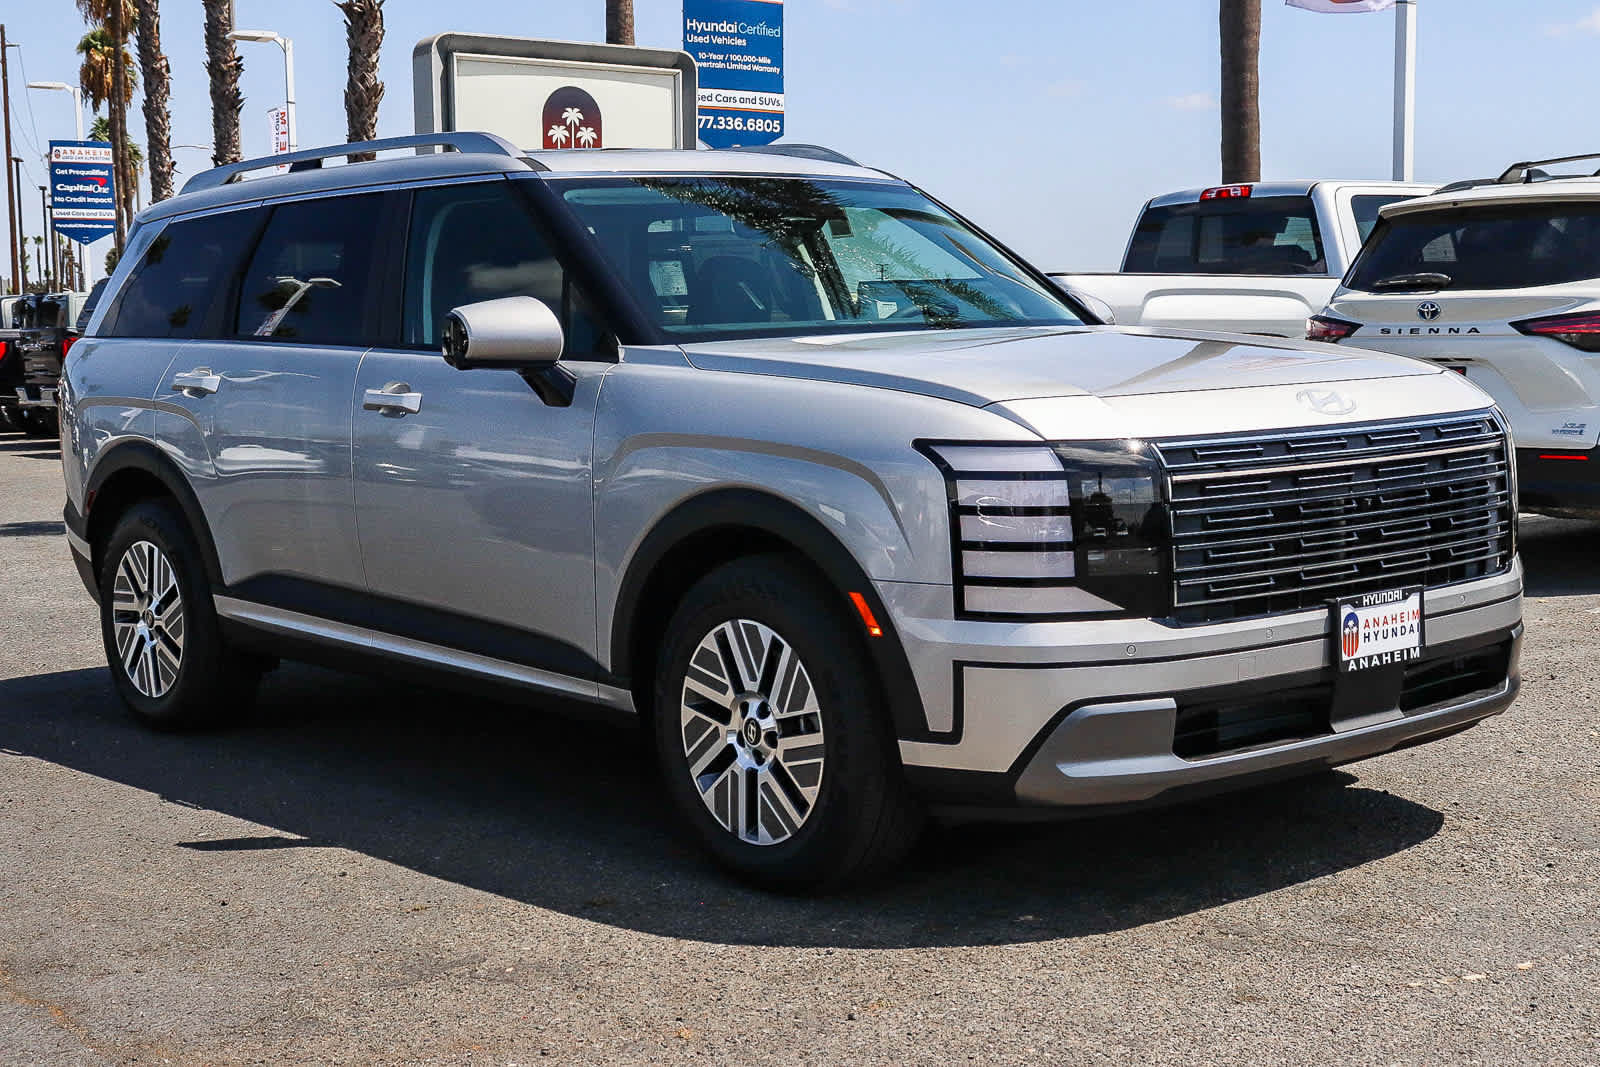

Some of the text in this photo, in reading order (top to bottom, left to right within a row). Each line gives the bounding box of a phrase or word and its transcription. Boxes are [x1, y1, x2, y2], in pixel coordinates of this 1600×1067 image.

[686, 18, 781, 38] Hyundai Certified
[686, 33, 747, 47] Used Vehicles
[698, 52, 724, 61] 10-Year
[730, 53, 771, 65] 100,000-Mile
[727, 62, 752, 72] Limited
[752, 64, 781, 75] Warranty
[714, 93, 737, 105] Cars
[738, 95, 757, 106] and
[758, 96, 784, 108] SUVs.
[62, 148, 111, 157] ANAHEIM
[1380, 327, 1481, 335] SIENNA
[1363, 589, 1403, 606] HYUNDAI
[1363, 609, 1420, 630] ANAHEIM
[1363, 622, 1421, 643] HYUNDAI
[1348, 646, 1421, 672] ANAHEIM
